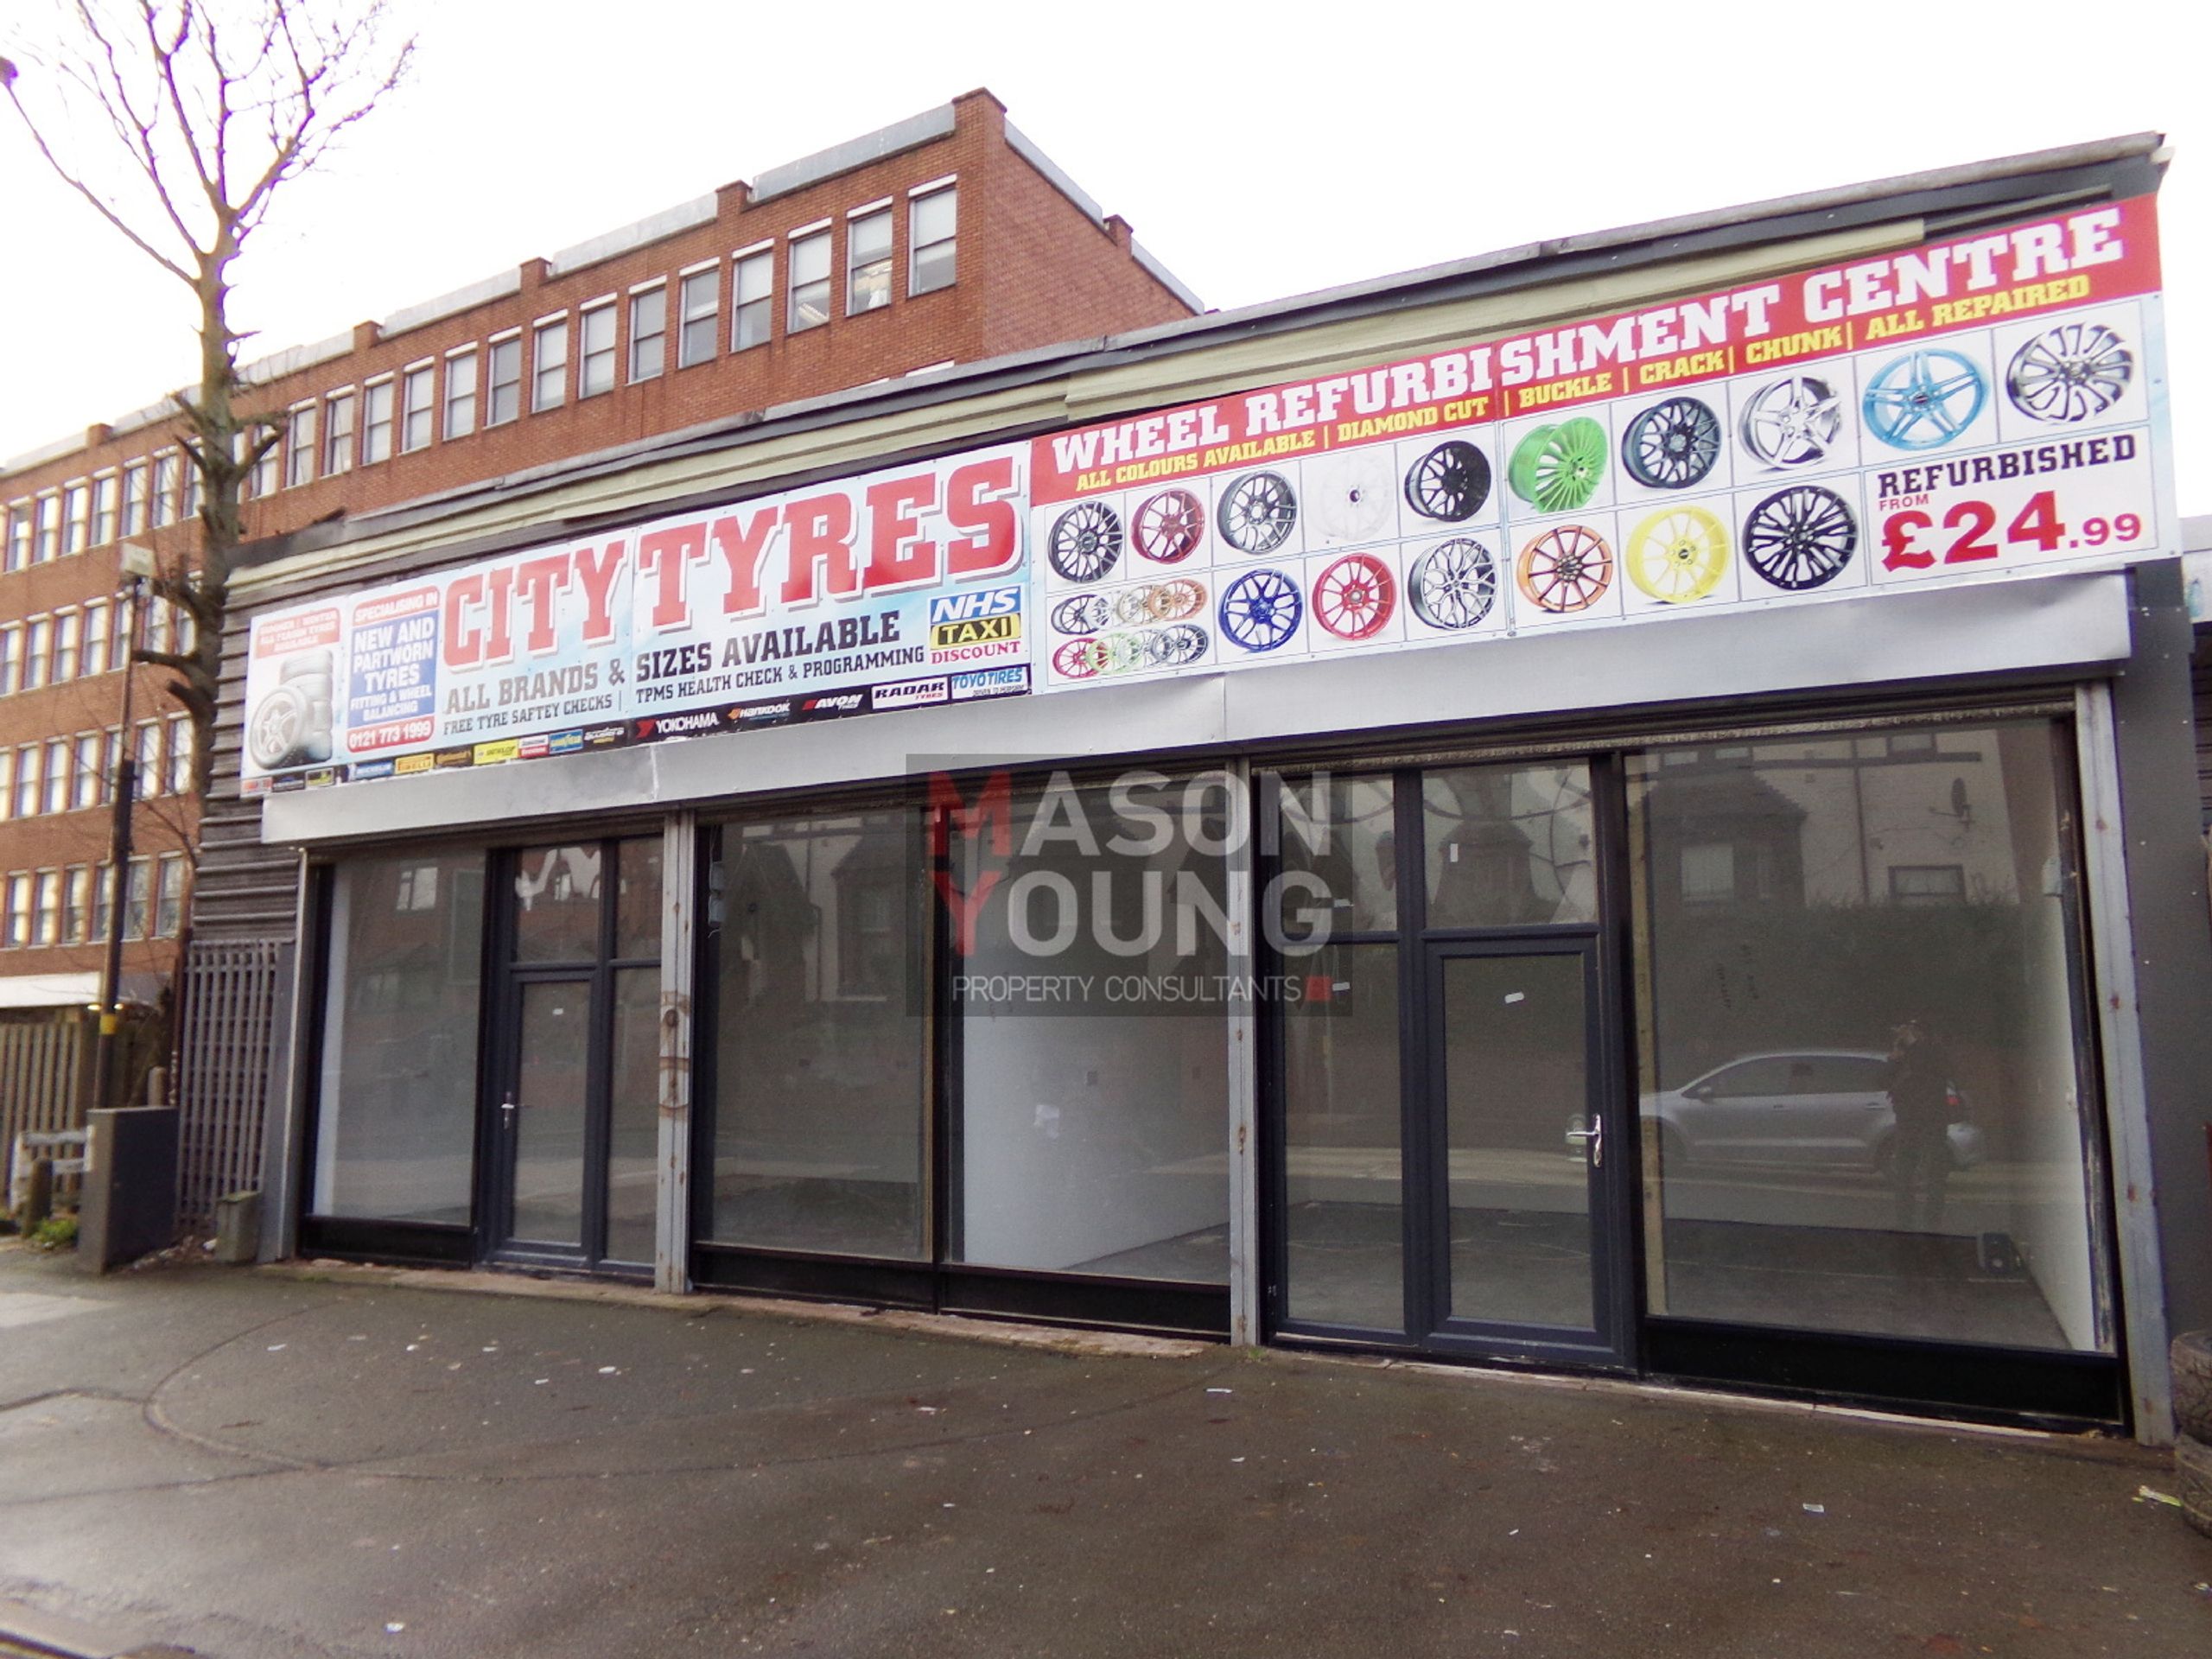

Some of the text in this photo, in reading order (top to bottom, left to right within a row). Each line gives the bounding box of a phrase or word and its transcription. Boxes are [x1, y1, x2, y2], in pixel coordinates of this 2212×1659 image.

[1052, 207, 2125, 474] WHEEL REFURBISHMENT CENTRE
[1076, 274, 2092, 493] ALL COLOURS AVAILABLE DIAMOND CUT BUCKLE CRACK CHUNK ALL REPAIRED
[1878, 434, 2137, 499] REFURBISHED
[1878, 493, 1929, 512] FROM
[1881, 490, 2142, 573] £24.99
[443, 455, 1016, 667] CITY TYRES
[931, 586, 1019, 624] NHS
[353, 616, 435, 652] NEW AND
[940, 617, 1014, 645] TAXI
[353, 639, 434, 674] PARTWORN
[446, 610, 900, 715] ALL BRANDS & SIZES AVAILABLE
[931, 641, 1021, 665] DISCOUNT
[364, 664, 420, 693] TYRES
[636, 645, 925, 704] TPMS HEALTH CHECK & PROGRAMMING
[874, 681, 945, 699] RADAR
[443, 692, 612, 735] FREE TYRE SAFTEY CHECKS
[814, 693, 863, 710] AVON
[349, 720, 431, 749] 0121 773 1999
[655, 712, 720, 734] YOKOHAMA
